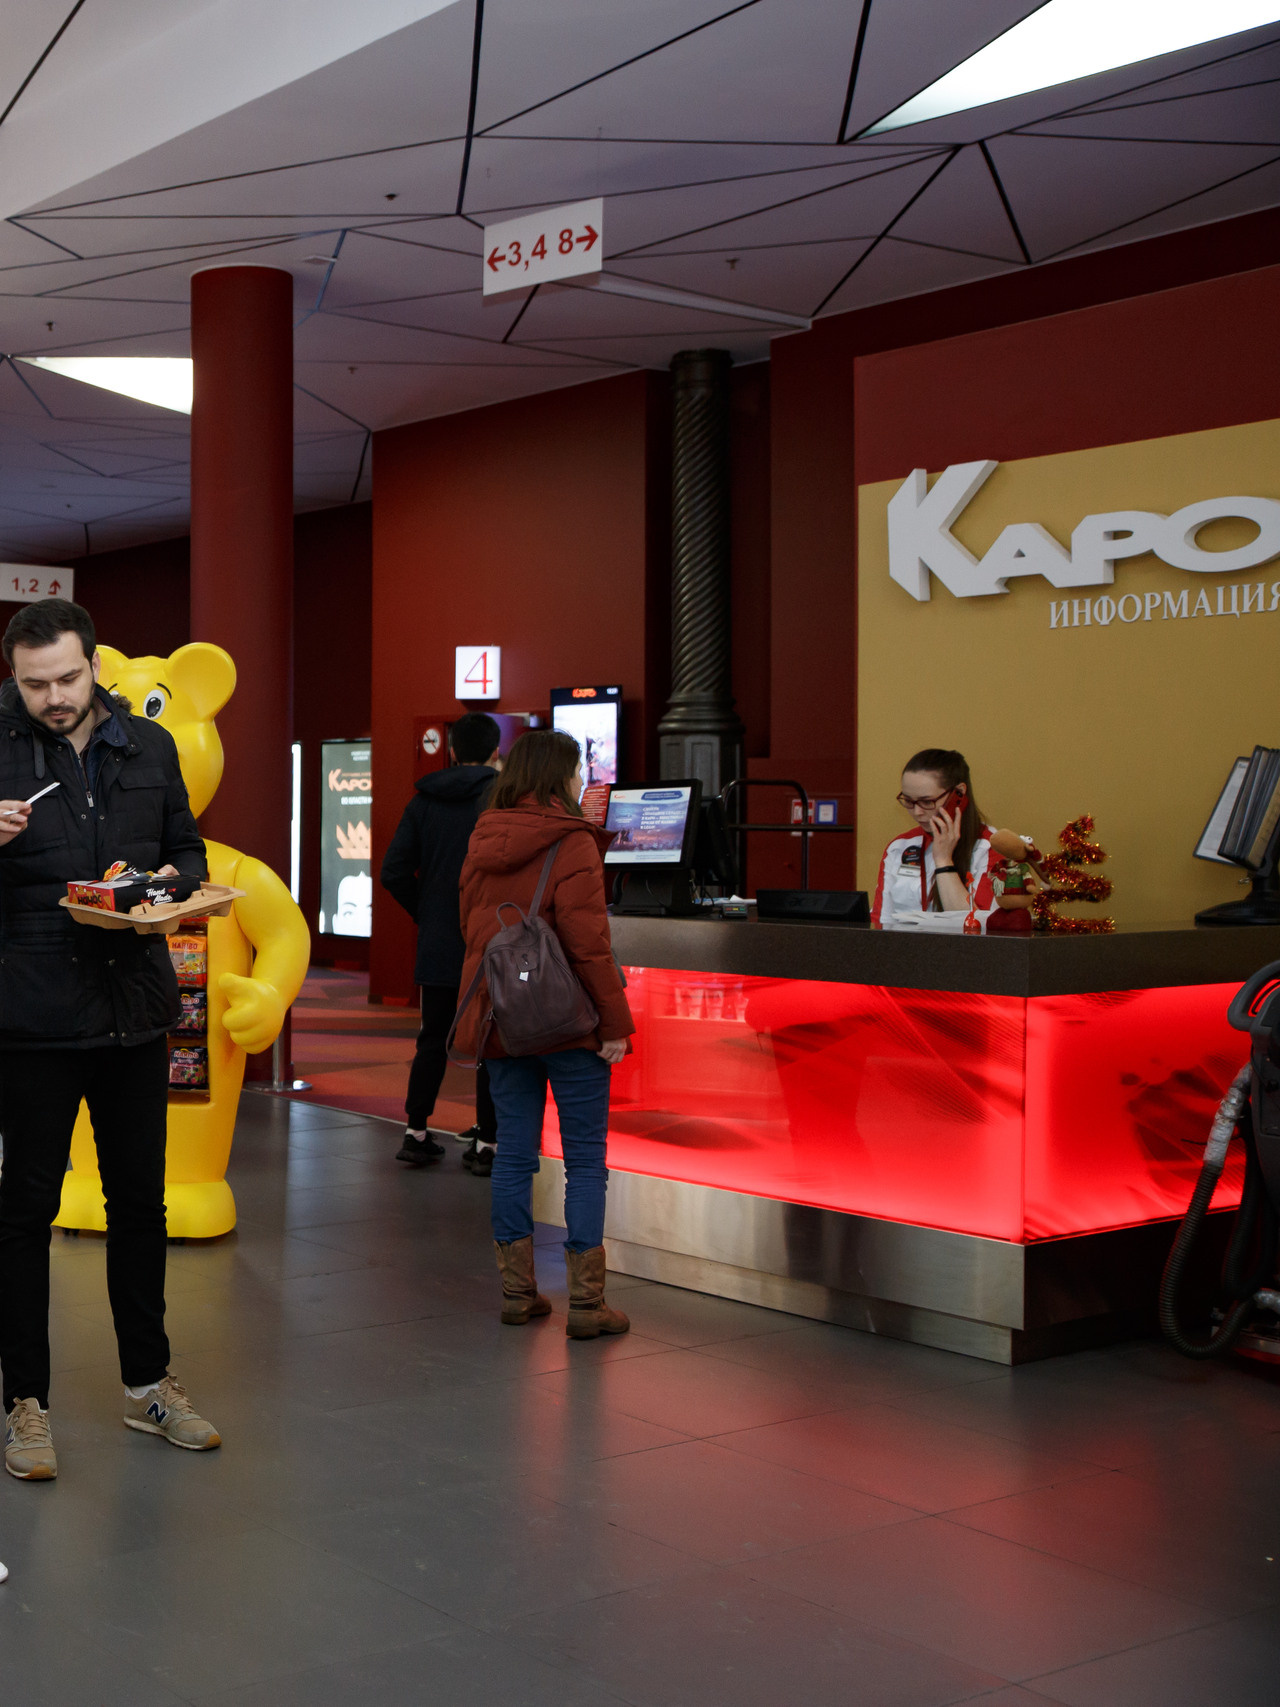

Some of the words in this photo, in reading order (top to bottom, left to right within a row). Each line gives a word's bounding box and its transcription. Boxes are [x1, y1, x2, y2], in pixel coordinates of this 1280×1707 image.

[508, 234, 547, 271] 3,4
[558, 228, 573, 254] 8
[887, 459, 1280, 601] КАРО
[12, 577, 39, 595] 1,2
[464, 651, 493, 694] 4
[146, 887, 166, 898] Hand
[172, 942, 198, 950] HARIBO
[146, 1401, 170, 1424] N
